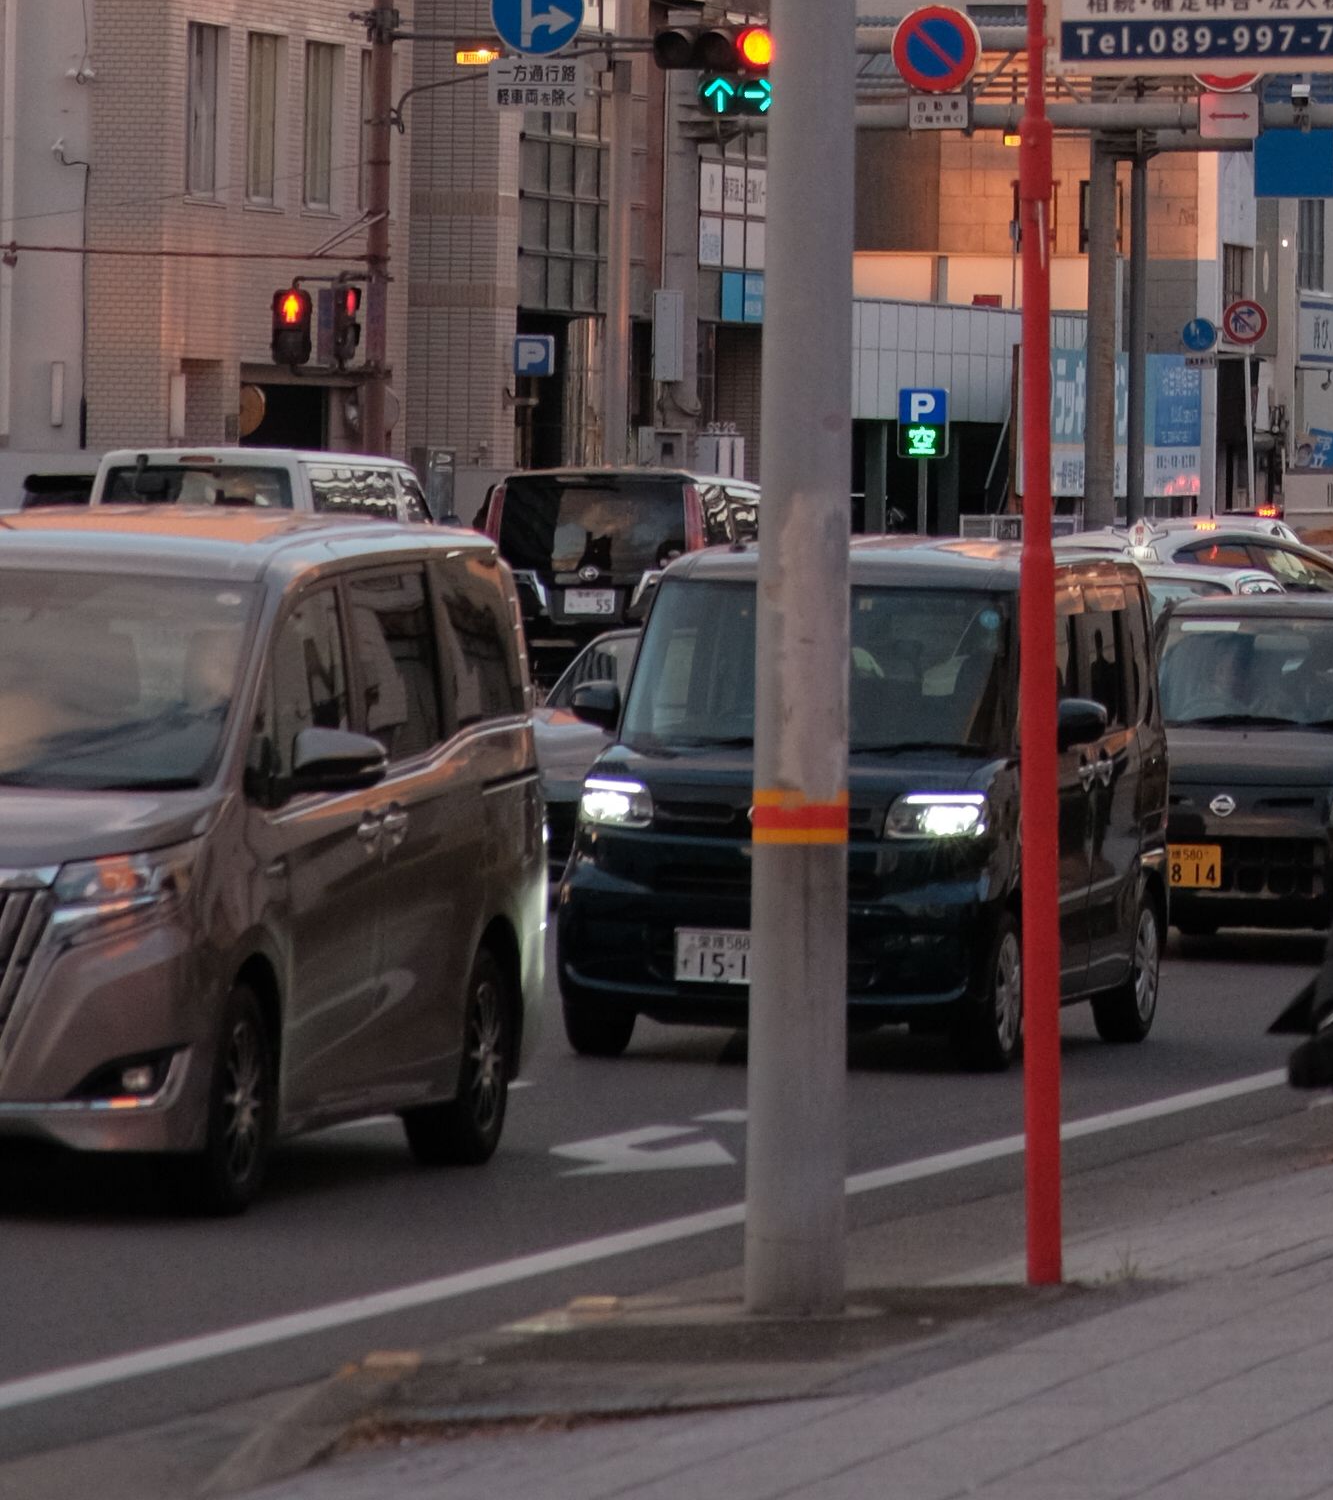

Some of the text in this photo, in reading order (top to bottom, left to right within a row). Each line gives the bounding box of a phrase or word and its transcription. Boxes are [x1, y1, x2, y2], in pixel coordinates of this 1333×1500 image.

[496, 64, 576, 82] 一方通行路
[496, 88, 576, 107] 軽車両を除く
[518, 341, 546, 371] P
[910, 392, 936, 422] P
[908, 425, 936, 455] 空
[700, 952, 747, 980] 15-1
